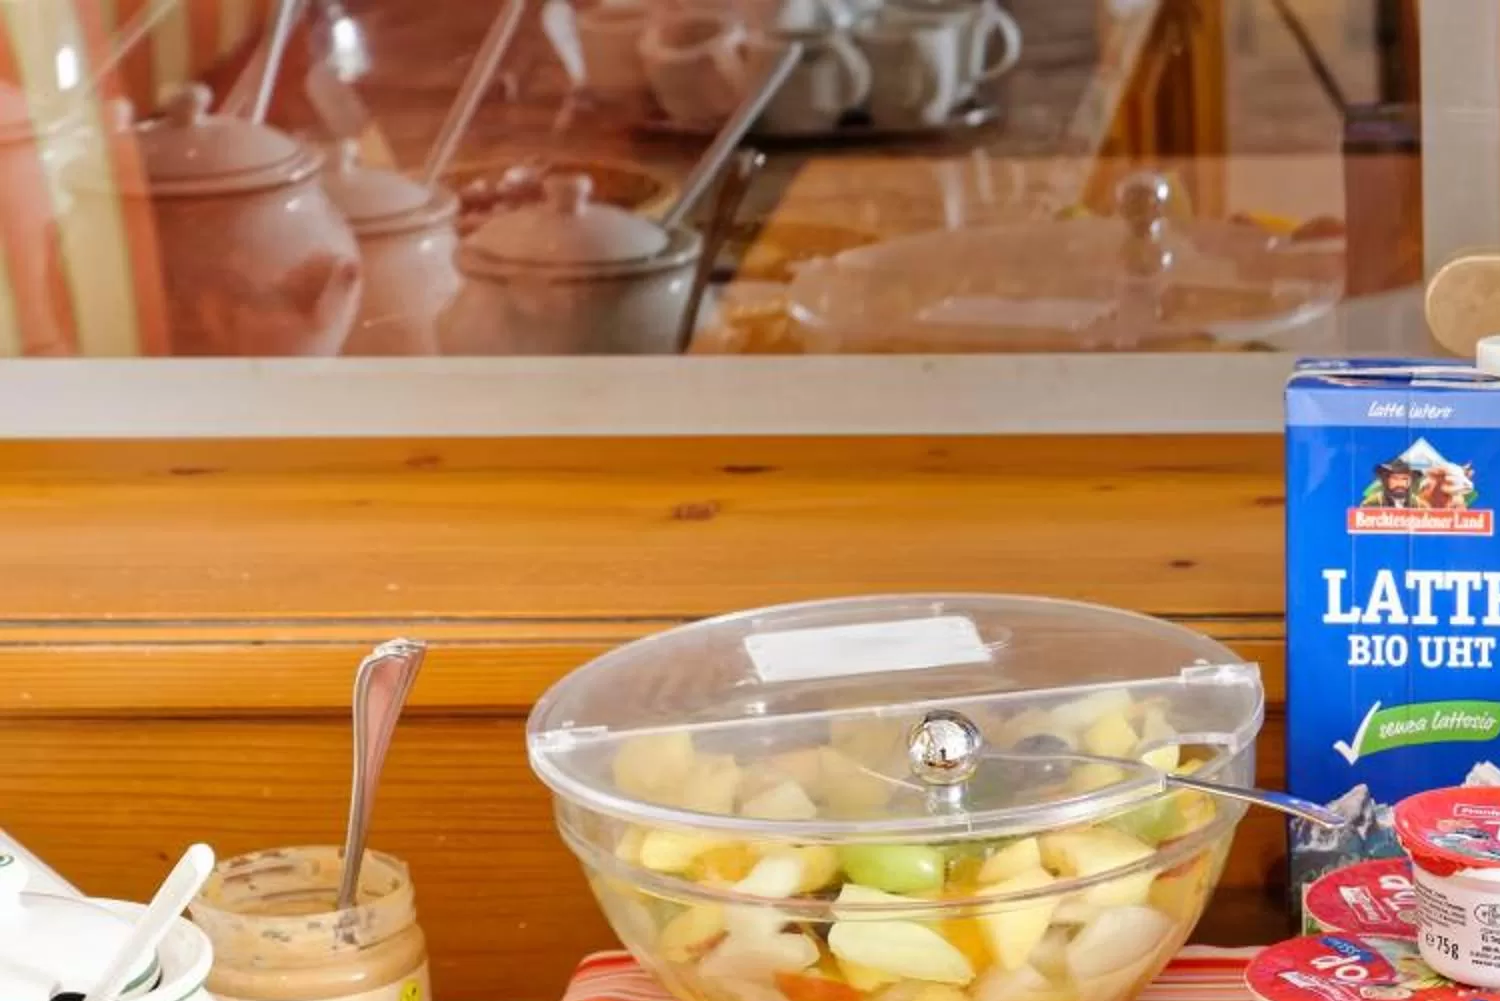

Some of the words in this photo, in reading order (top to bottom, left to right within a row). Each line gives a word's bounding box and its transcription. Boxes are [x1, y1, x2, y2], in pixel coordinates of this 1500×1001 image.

[1454, 511, 1485, 530] Land
[1347, 634, 1409, 667] BIO
[1417, 635, 1497, 669] UHT
